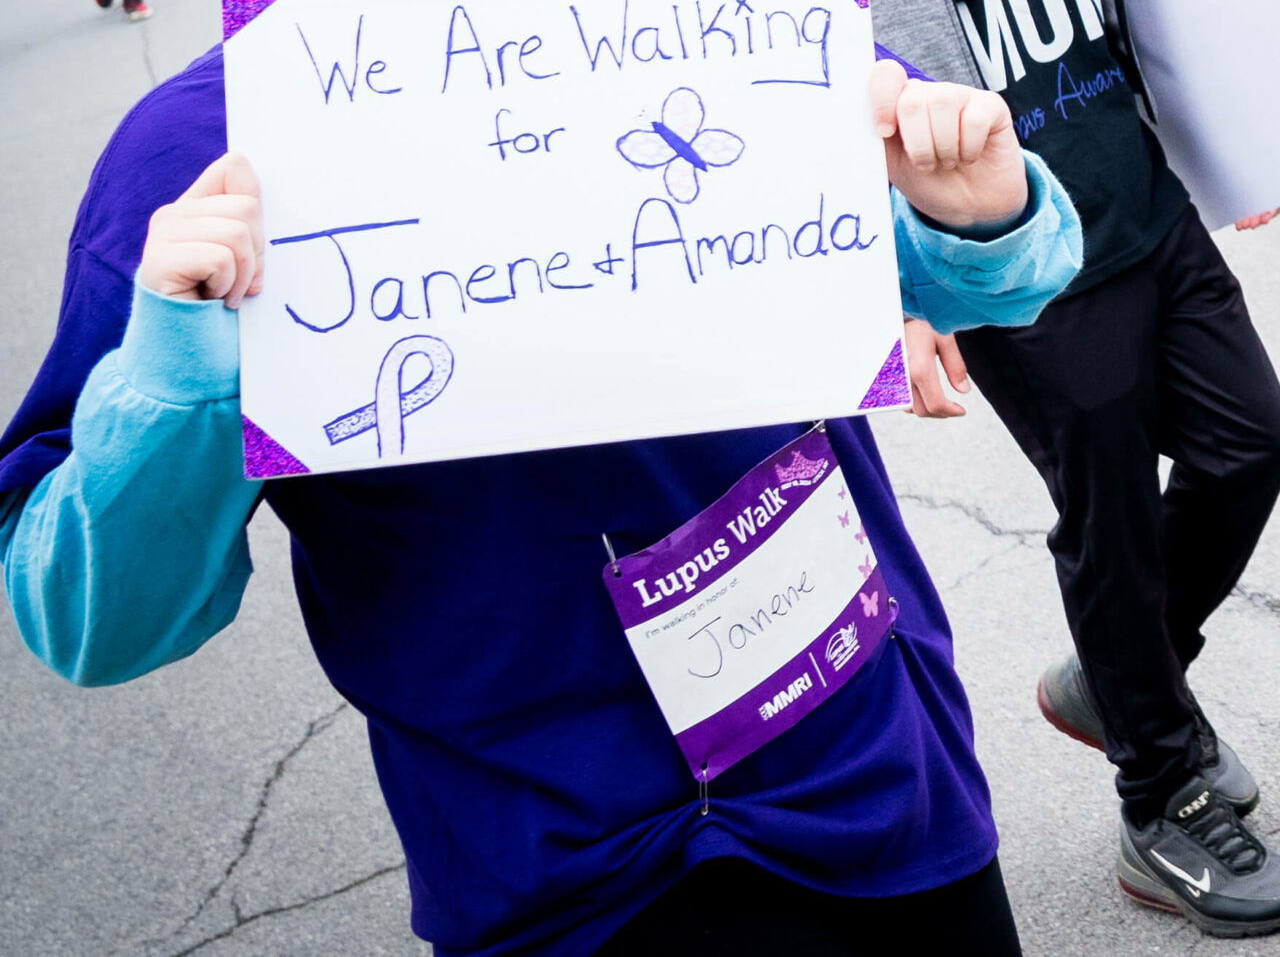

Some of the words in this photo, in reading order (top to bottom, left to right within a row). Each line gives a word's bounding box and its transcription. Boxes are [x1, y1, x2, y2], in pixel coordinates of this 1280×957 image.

[294, 13, 403, 104] We
[441, 5, 561, 95] Are
[488, 108, 566, 161] for
[269, 218, 593, 333] Janene
[630, 194, 881, 292] Amanda
[633, 537, 730, 608] Lupus
[727, 486, 788, 544] Walk
[662, 609, 697, 631] walking
[705, 586, 728, 605] honor
[688, 571, 815, 678] Janene
[764, 672, 813, 718] MMRI
